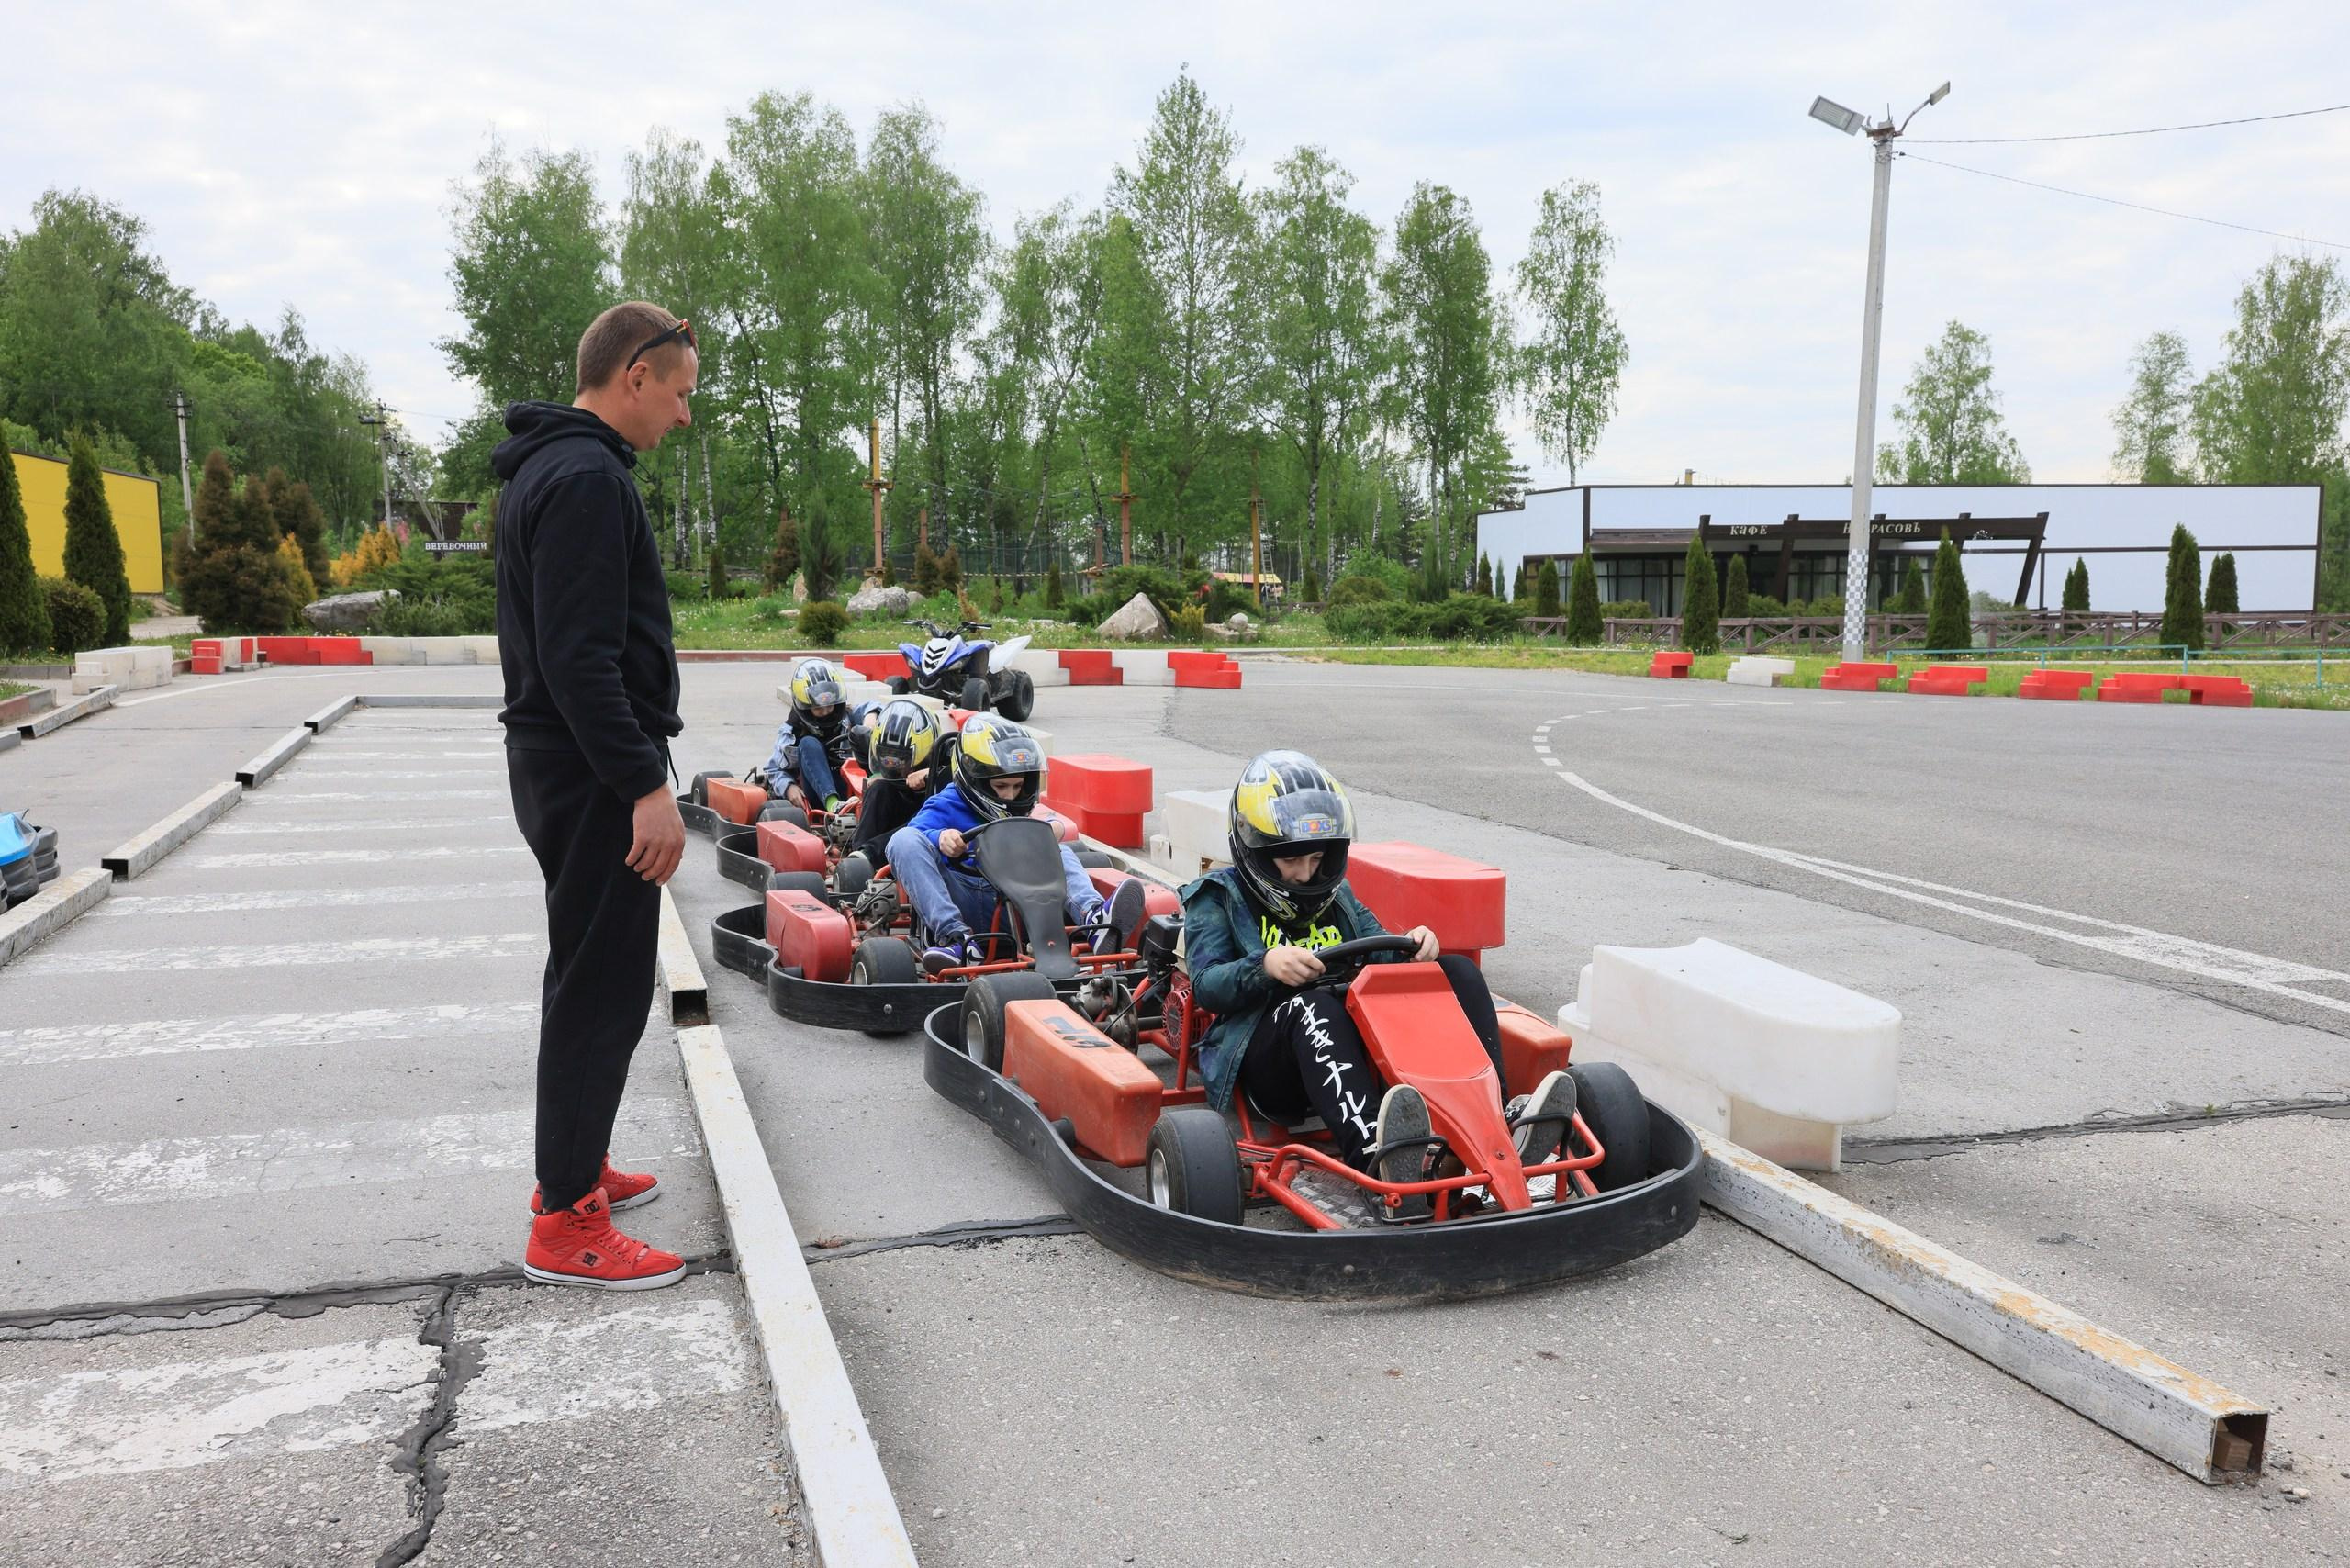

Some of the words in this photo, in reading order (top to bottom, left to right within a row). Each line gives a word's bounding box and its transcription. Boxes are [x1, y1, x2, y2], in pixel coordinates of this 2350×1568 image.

[1842, 522, 1921, 534] НРАСОВЪ
[583, 1199, 601, 1215] DC
[582, 1252, 599, 1267] DC
